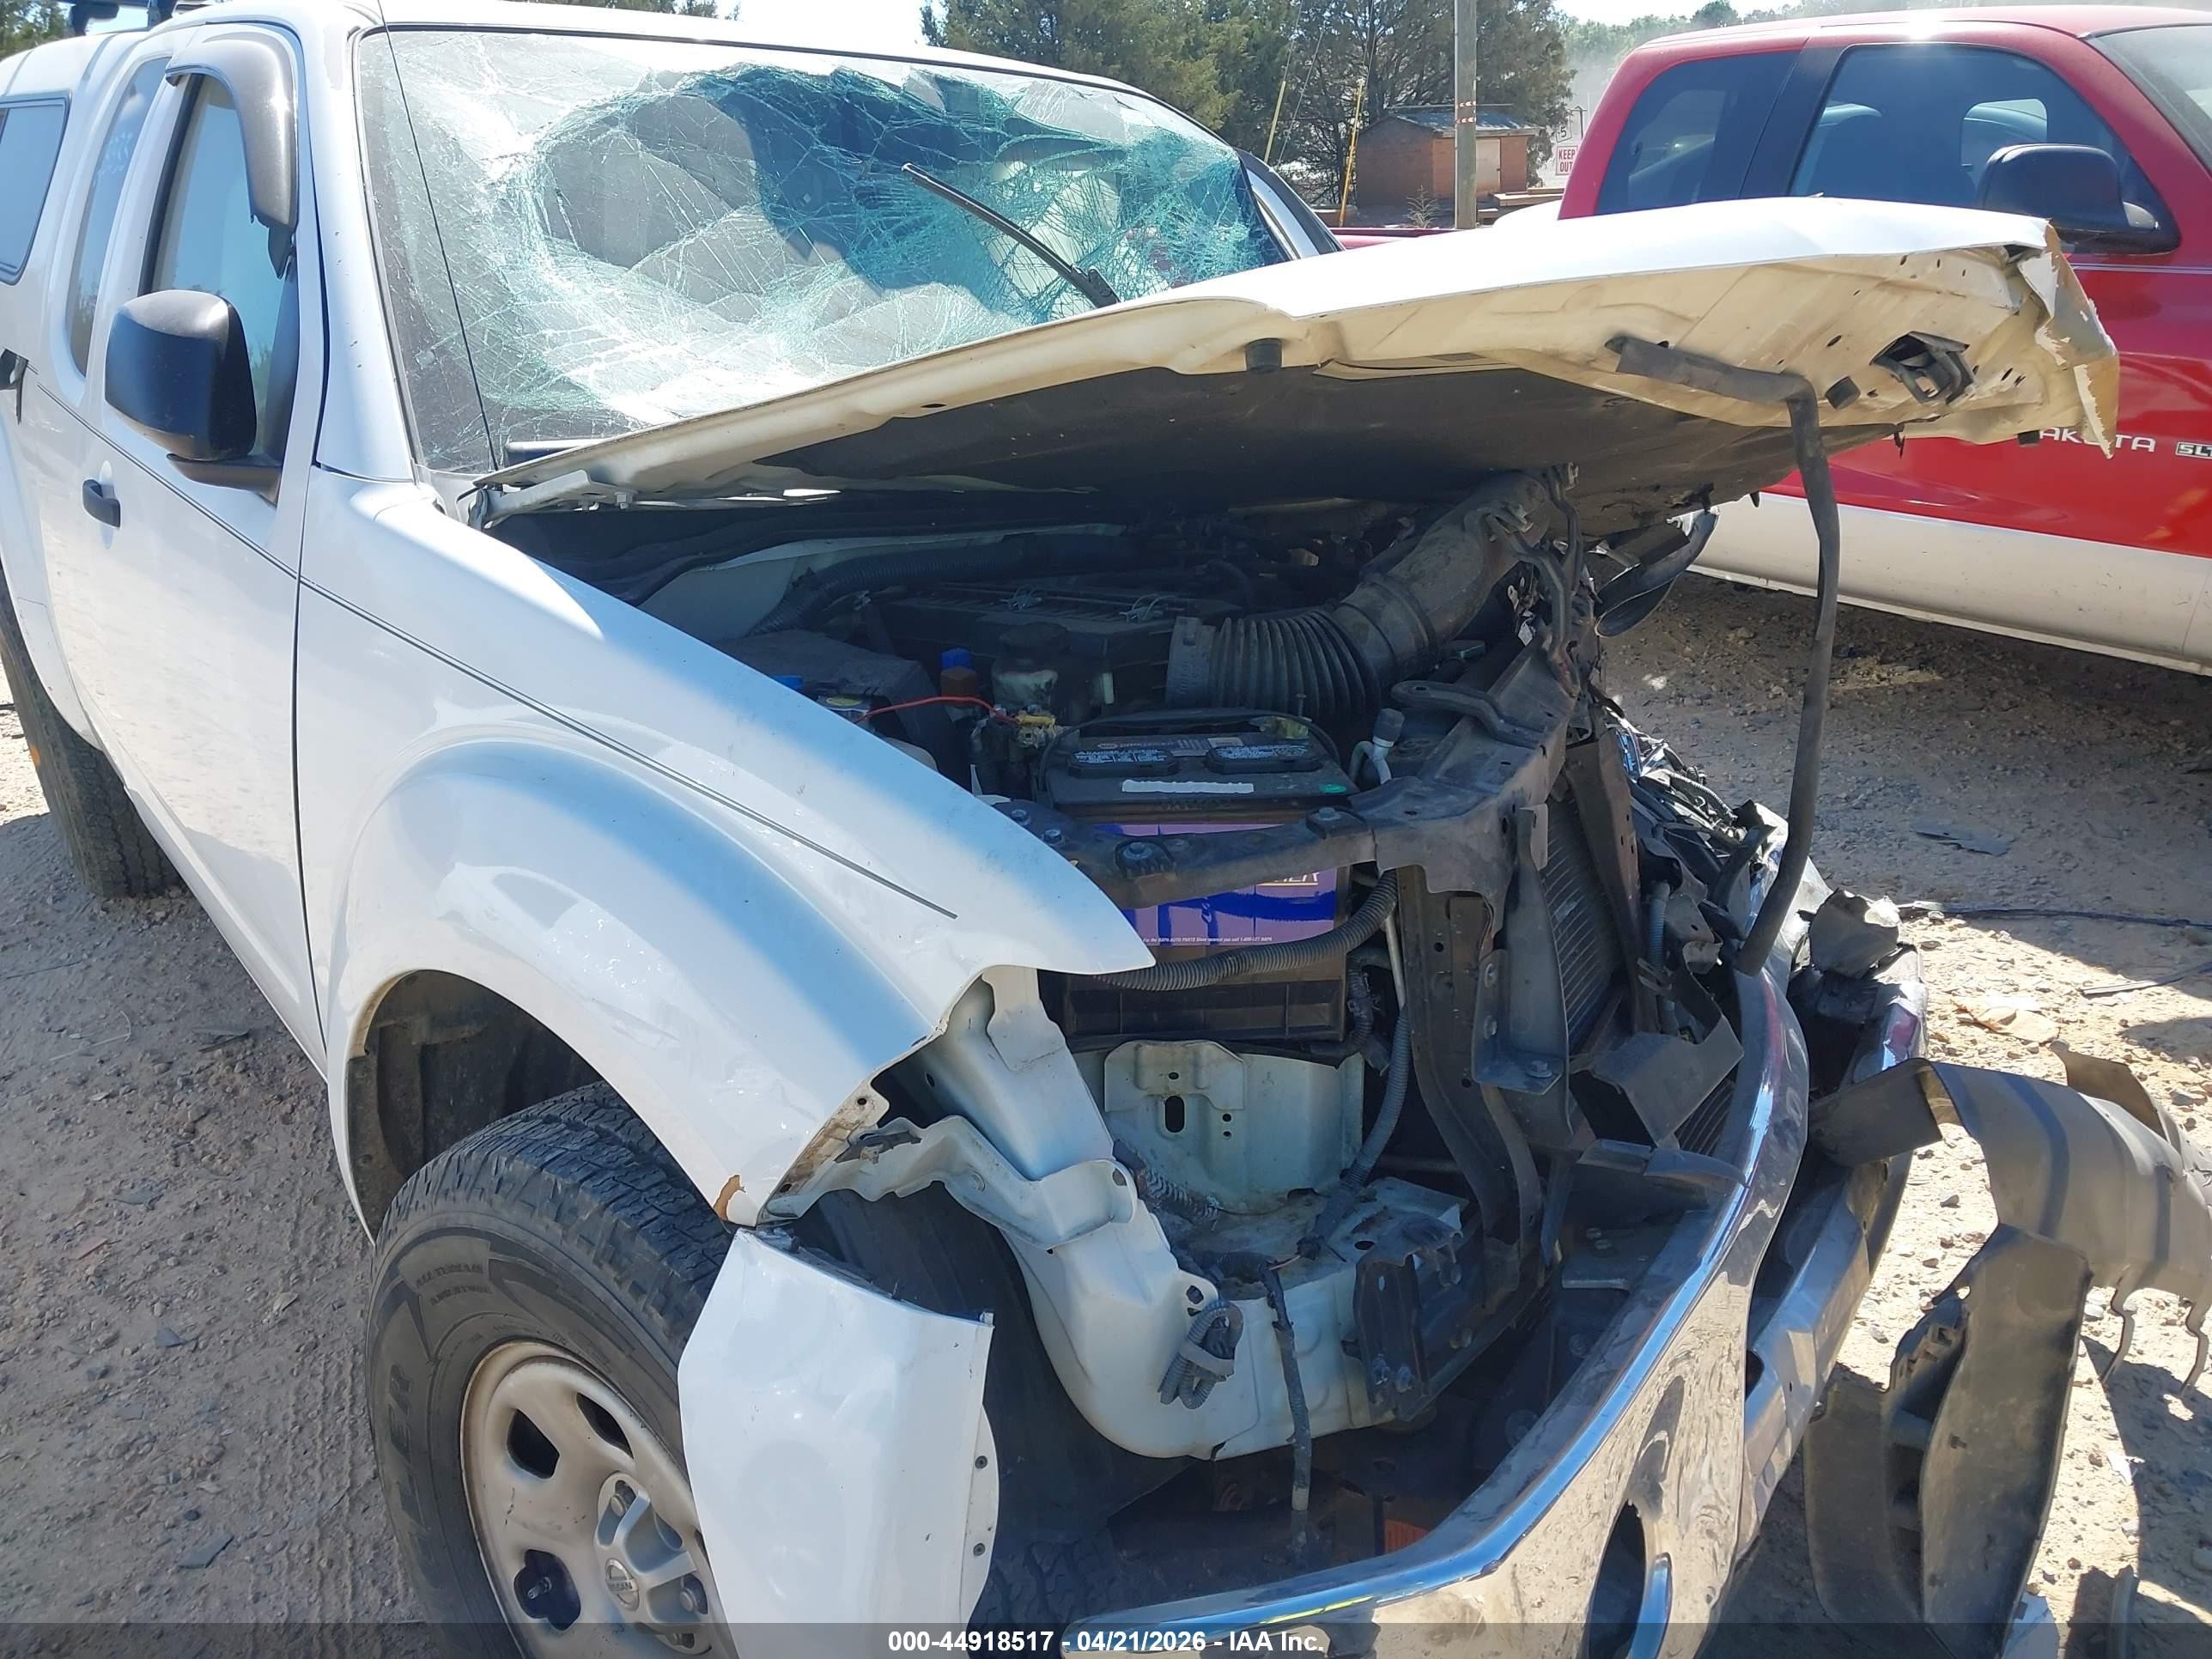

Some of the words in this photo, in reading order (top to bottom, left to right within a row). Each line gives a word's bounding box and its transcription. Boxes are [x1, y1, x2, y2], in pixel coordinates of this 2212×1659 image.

[1559, 149, 1576, 160] KEEP
[1559, 161, 1573, 173] OUT
[2039, 427, 2156, 453] AKTA
